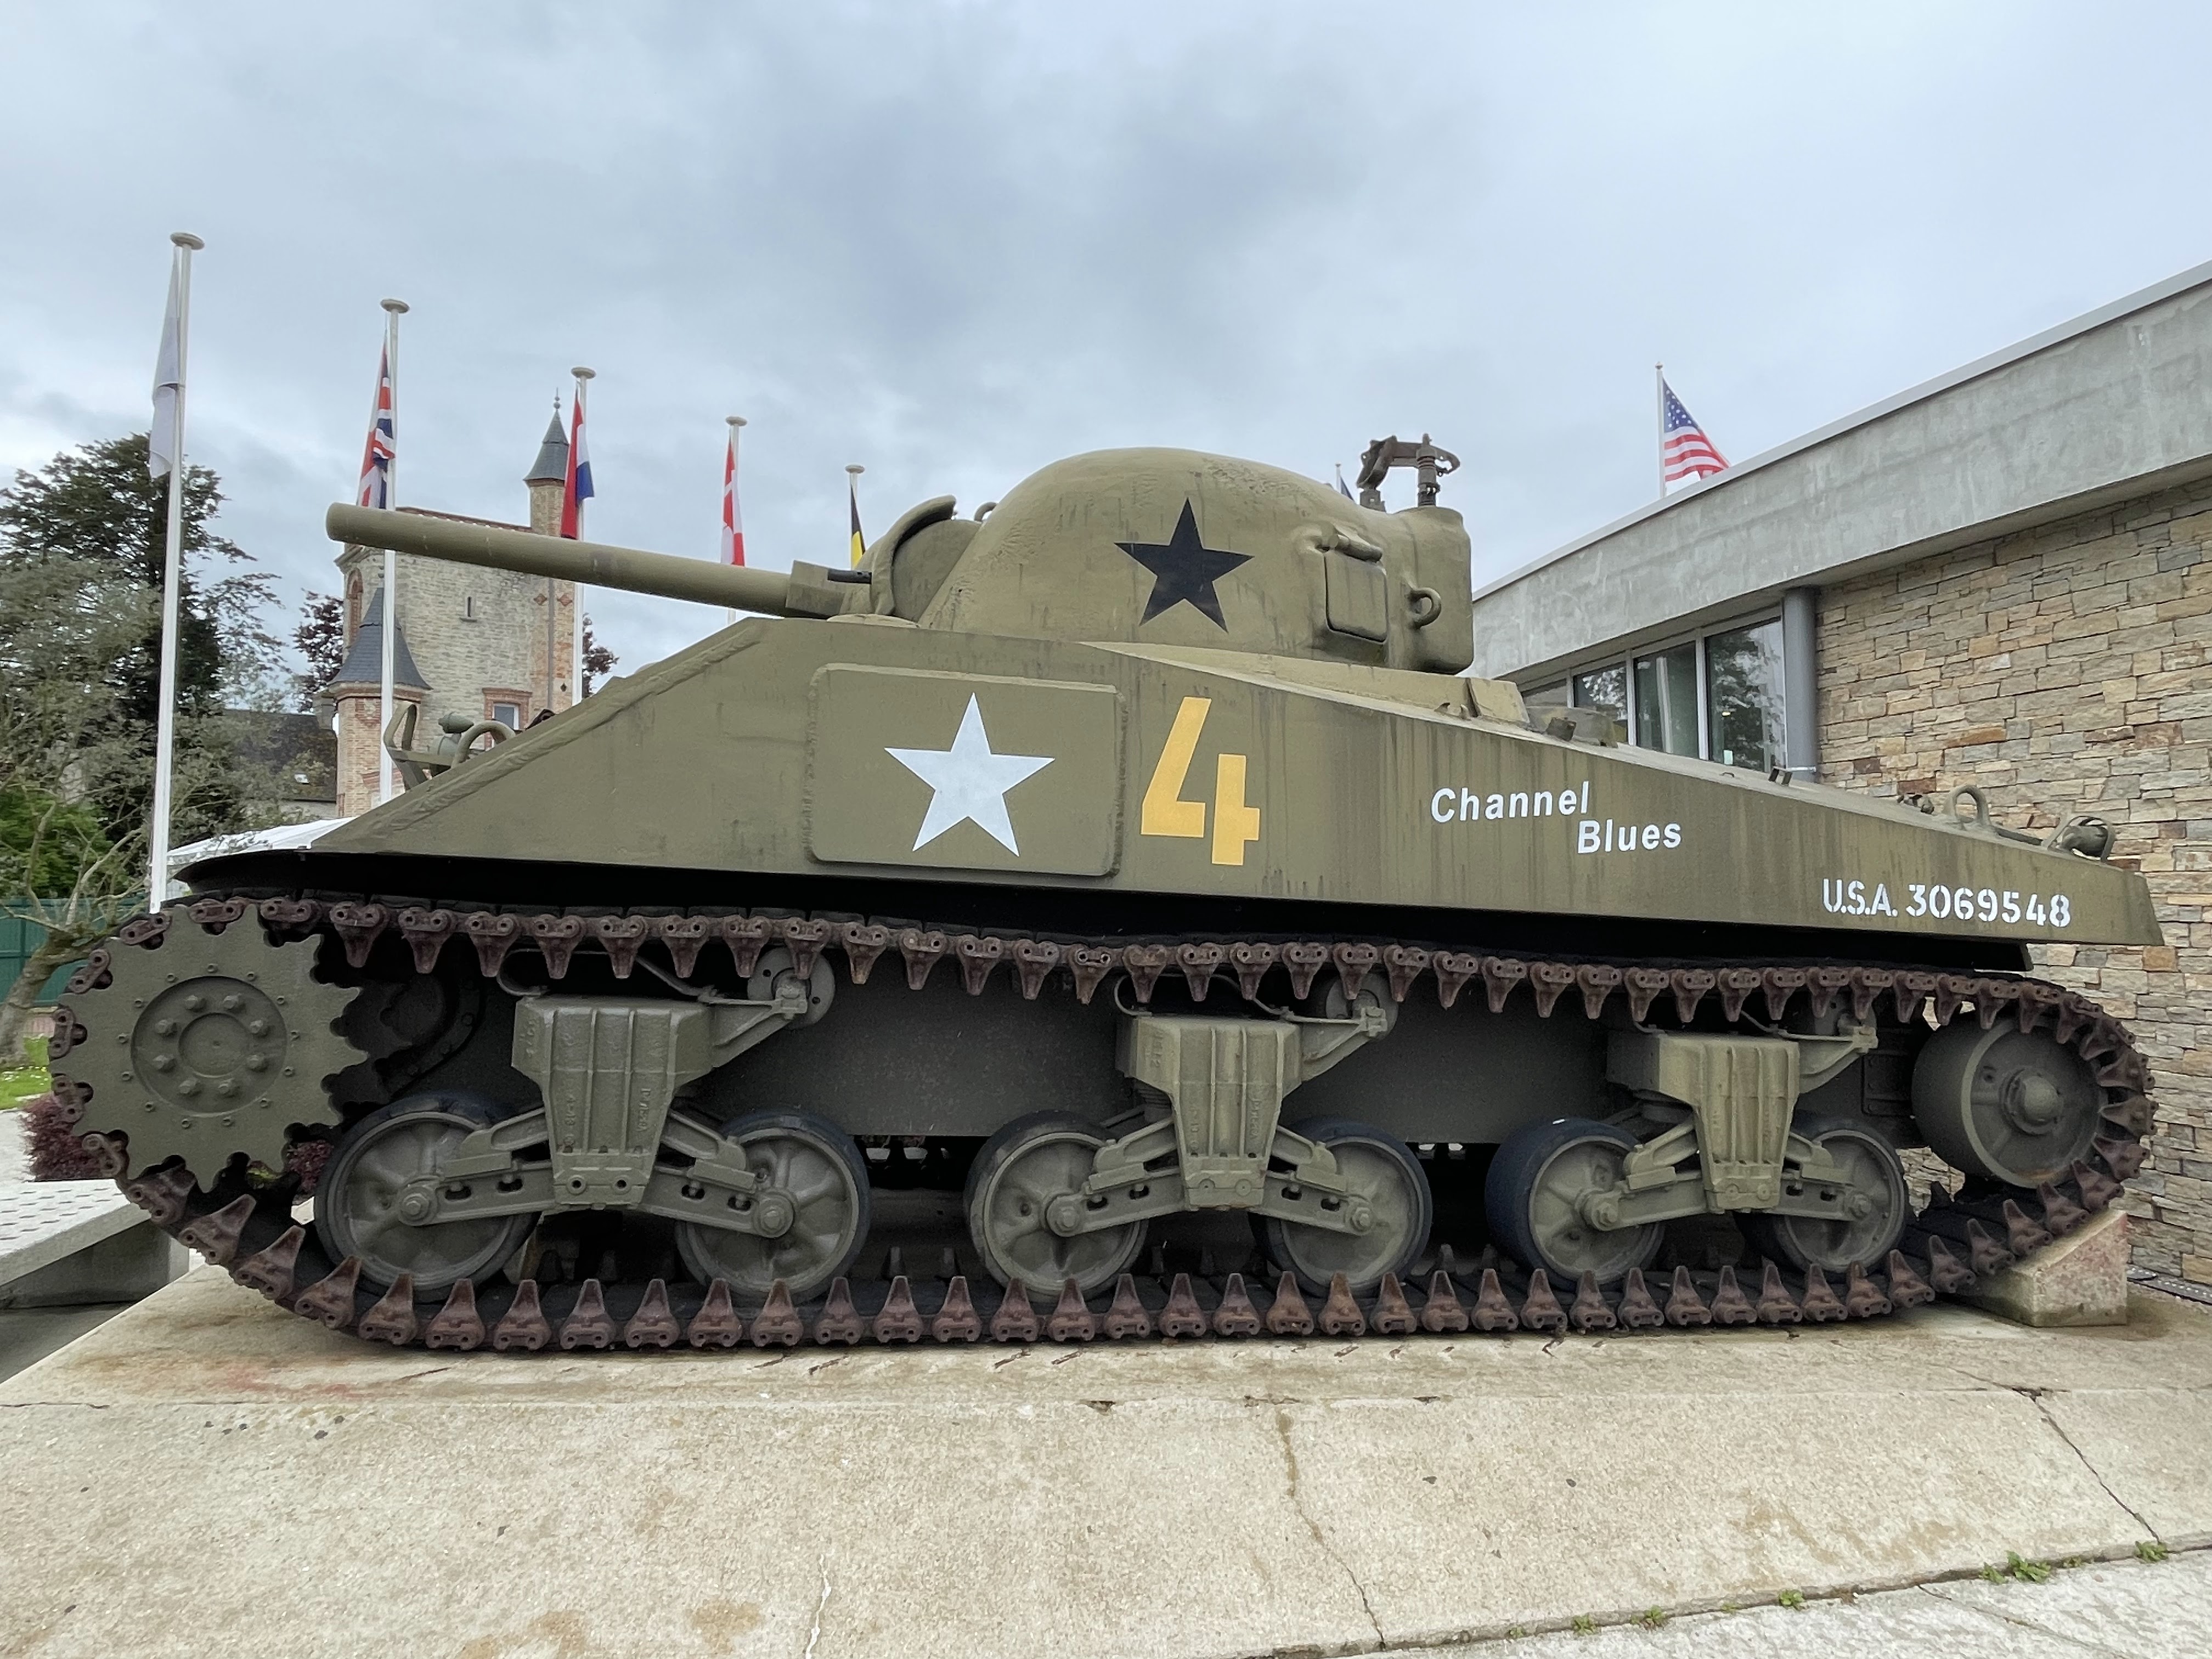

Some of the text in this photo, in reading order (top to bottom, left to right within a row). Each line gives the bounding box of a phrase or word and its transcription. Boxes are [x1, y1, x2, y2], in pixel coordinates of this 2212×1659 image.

[1141, 697, 1260, 865] 4
[1431, 781, 1589, 822] Channel
[1577, 819, 1681, 854] Blues
[1822, 878, 2071, 928] U.S.A. 3069548
